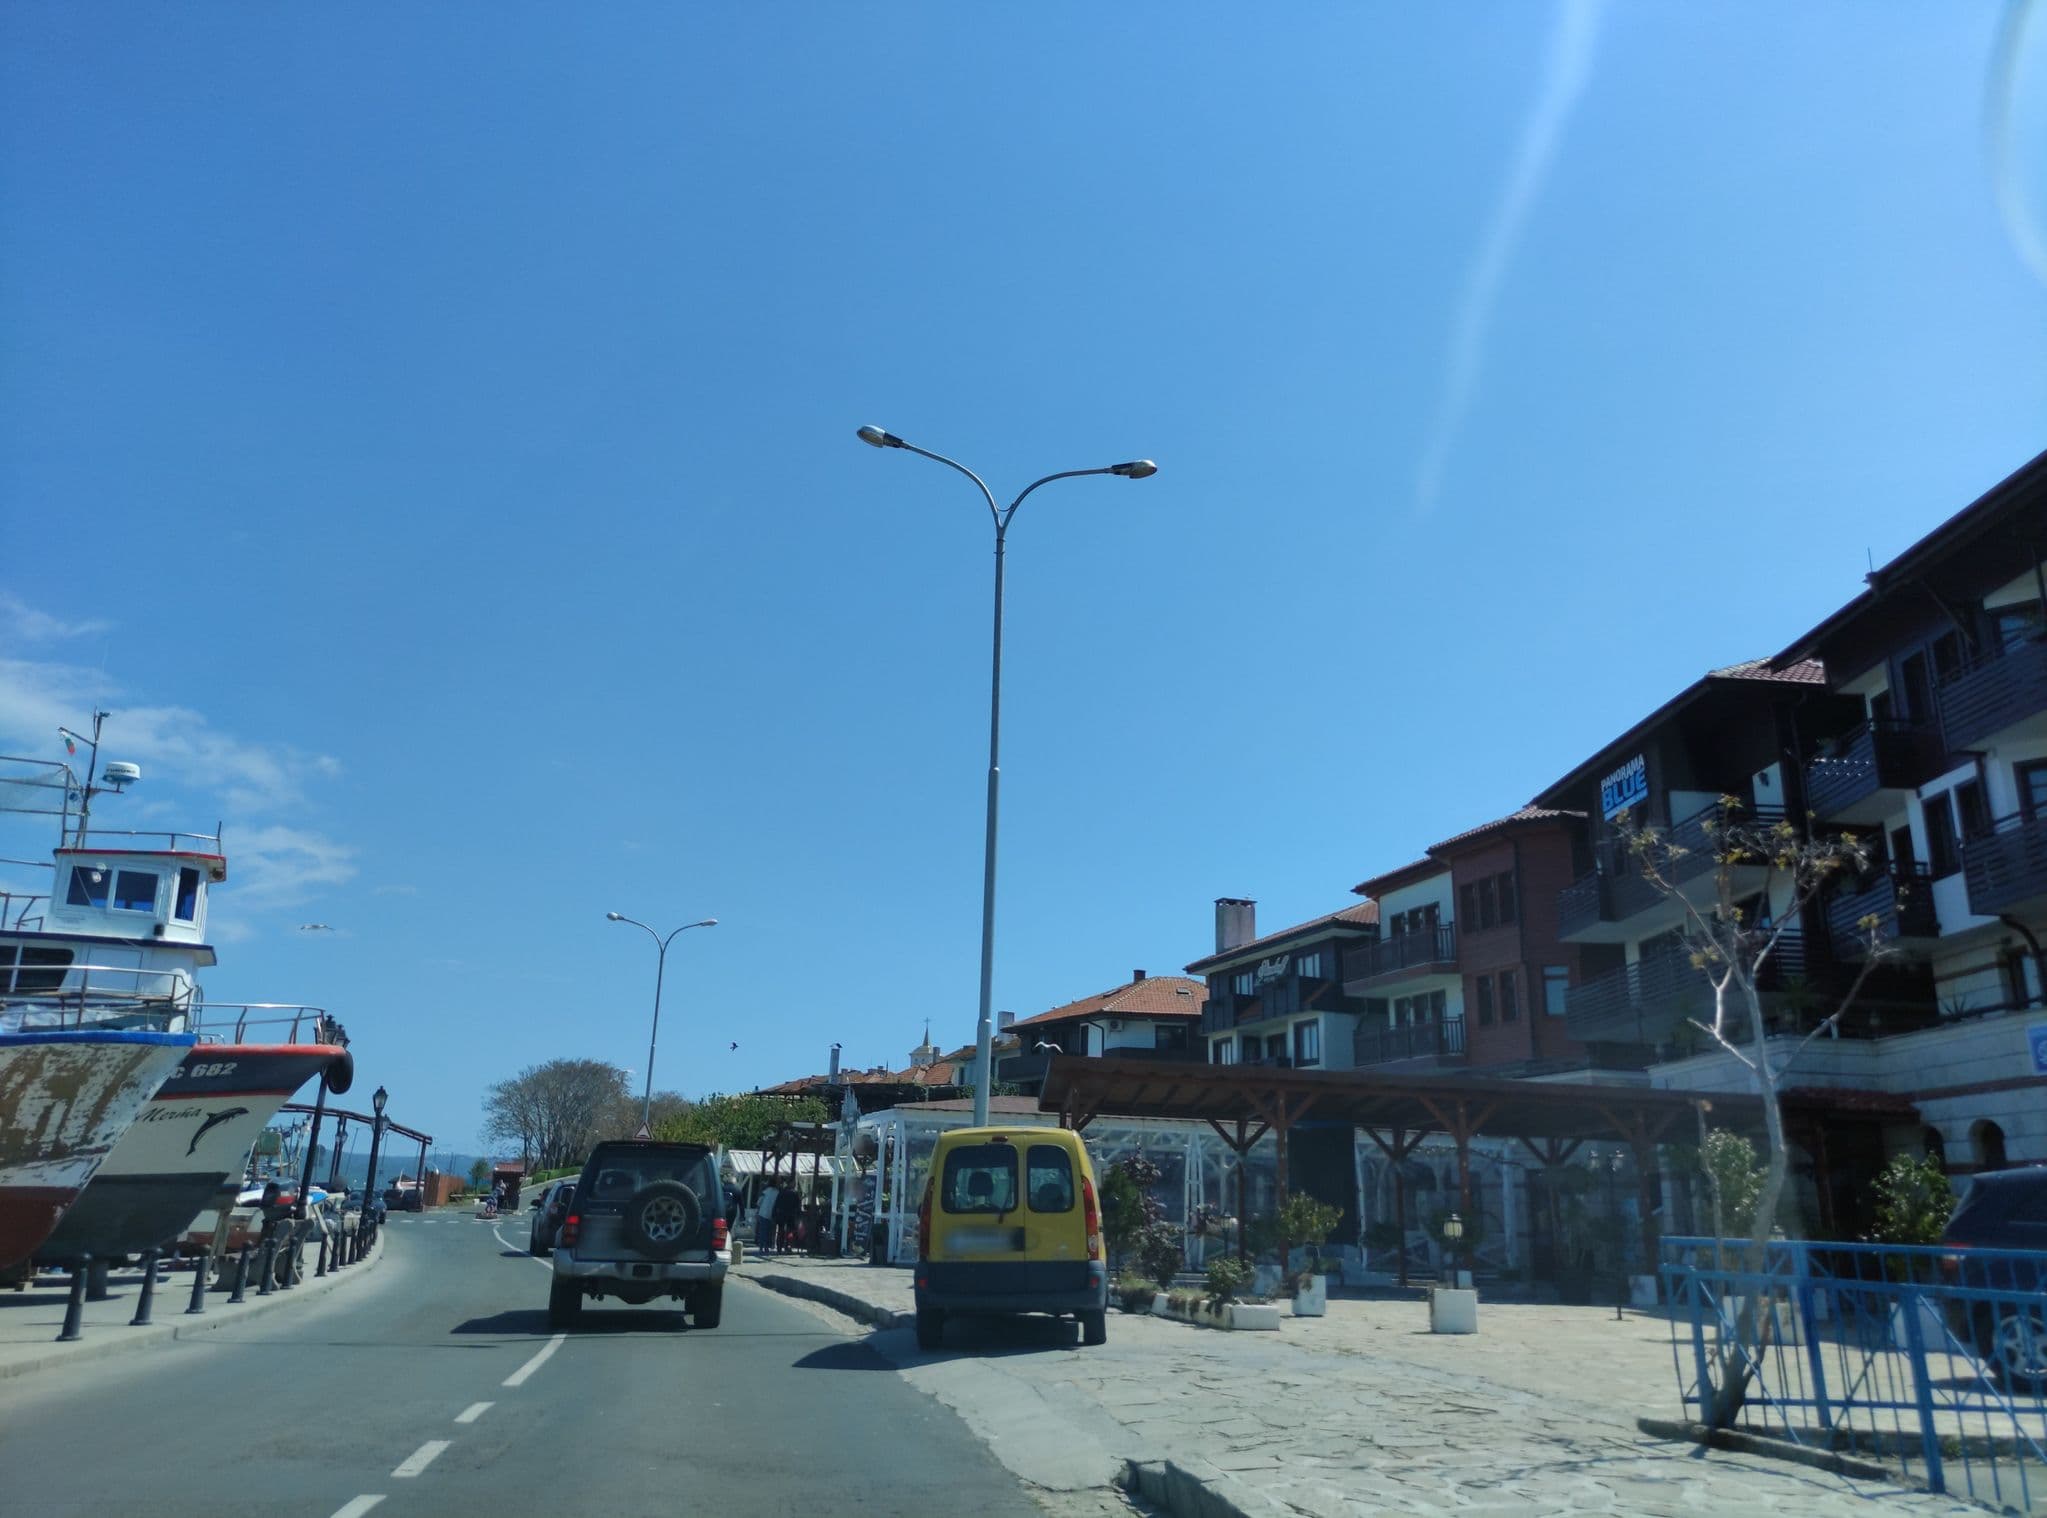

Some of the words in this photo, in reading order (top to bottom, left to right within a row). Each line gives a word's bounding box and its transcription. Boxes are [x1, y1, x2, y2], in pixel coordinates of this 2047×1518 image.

[1600, 754, 1645, 792] PANORAMA
[1602, 769, 1647, 812] BLUE
[191, 1062, 239, 1078] 682
